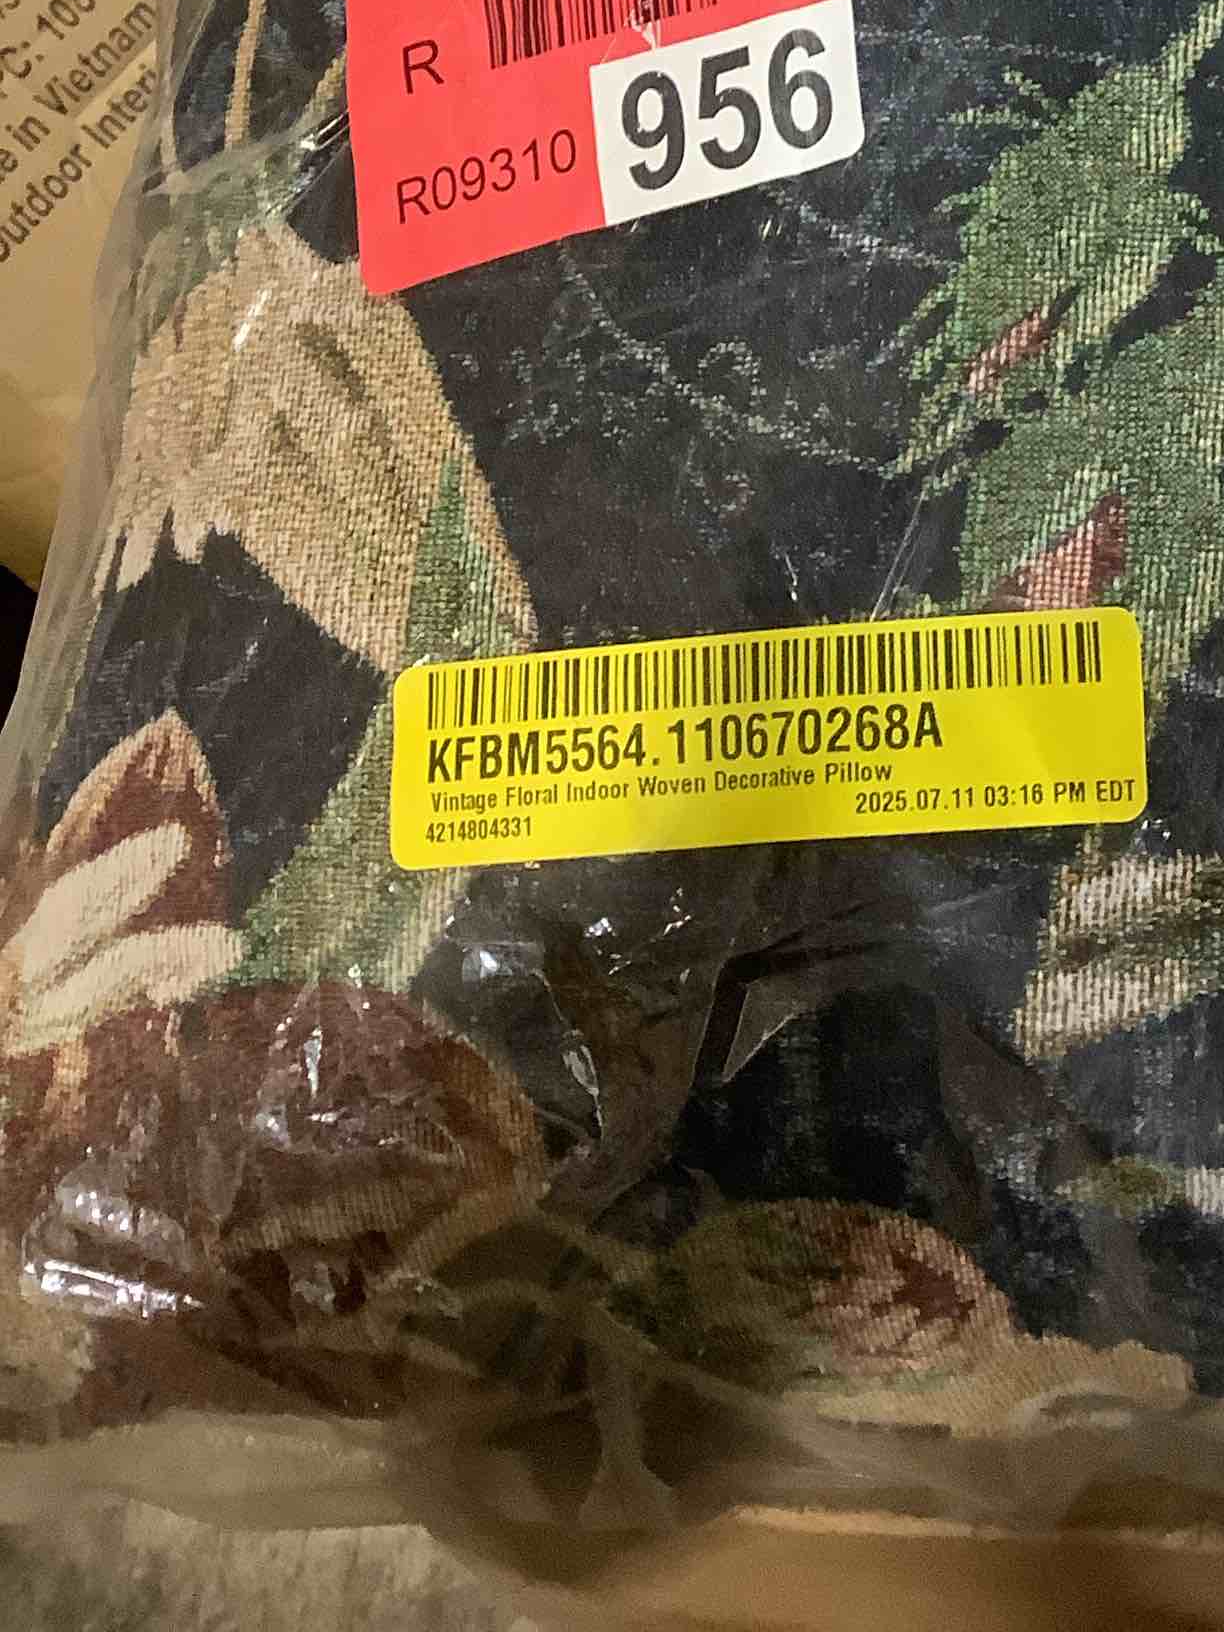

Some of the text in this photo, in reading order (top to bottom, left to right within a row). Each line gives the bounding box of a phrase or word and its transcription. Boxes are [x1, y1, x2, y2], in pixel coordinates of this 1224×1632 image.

[0, 40, 46, 81] C:
[401, 39, 445, 95] R
[5, 115, 51, 152] in
[620, 28, 834, 191] 956
[395, 128, 577, 225] R09310
[427, 701, 944, 784] KFBM5564.110670268A
[430, 761, 892, 815] Vintage Floral Indoor Woven Decorative Pillow
[855, 778, 1136, 814] 2025.07.11 03:16 PM EDT
[425, 815, 532, 844] 4214804331
